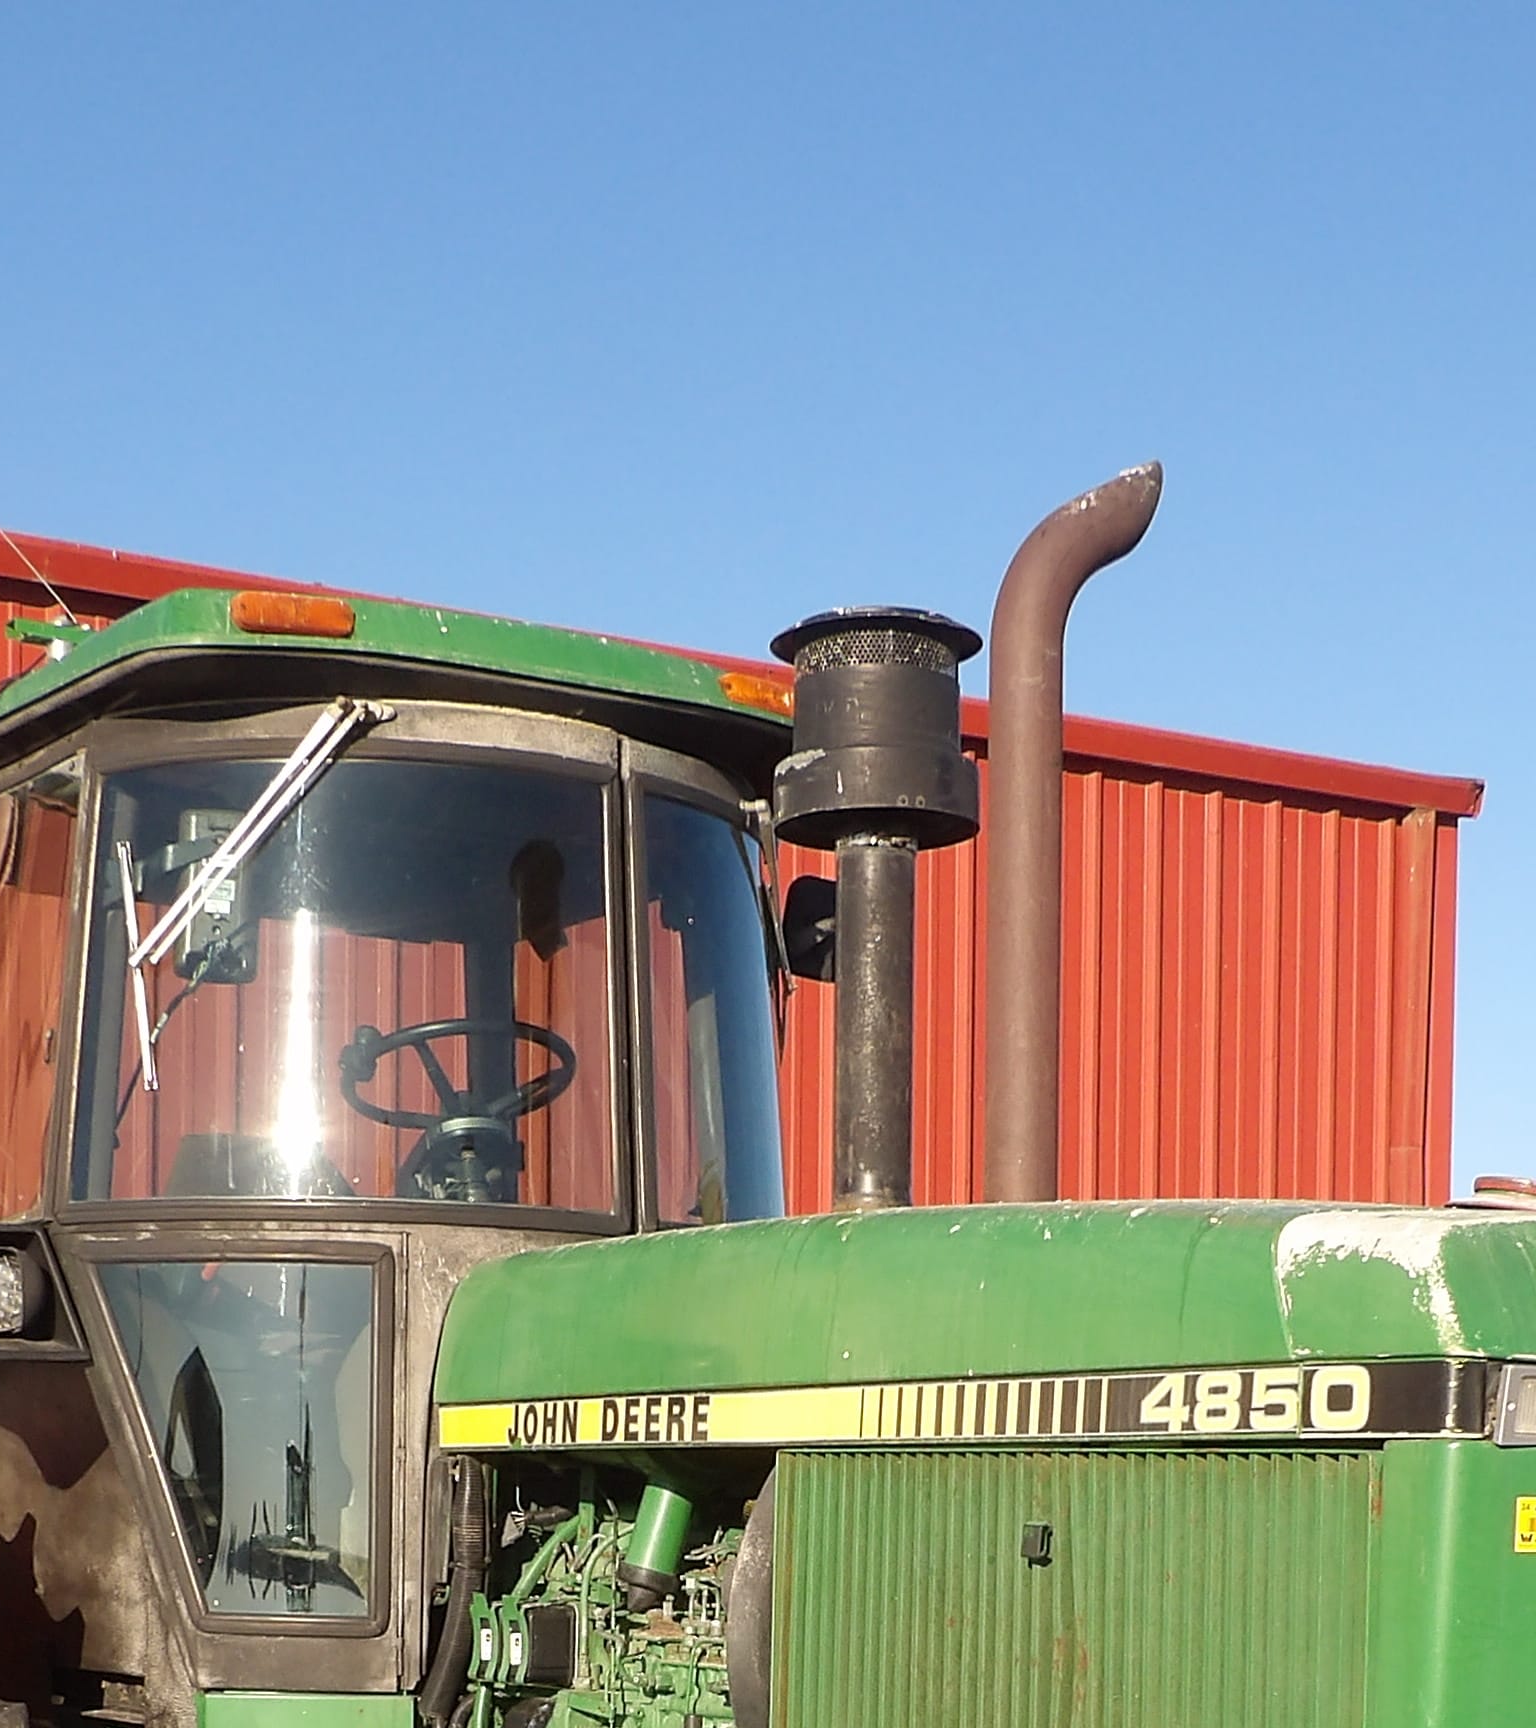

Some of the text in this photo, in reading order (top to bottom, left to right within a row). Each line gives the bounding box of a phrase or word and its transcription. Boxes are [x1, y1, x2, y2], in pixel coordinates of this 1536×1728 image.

[508, 1396, 710, 1445] JOHN DEERE
[1140, 1365, 1371, 1433] 4850
